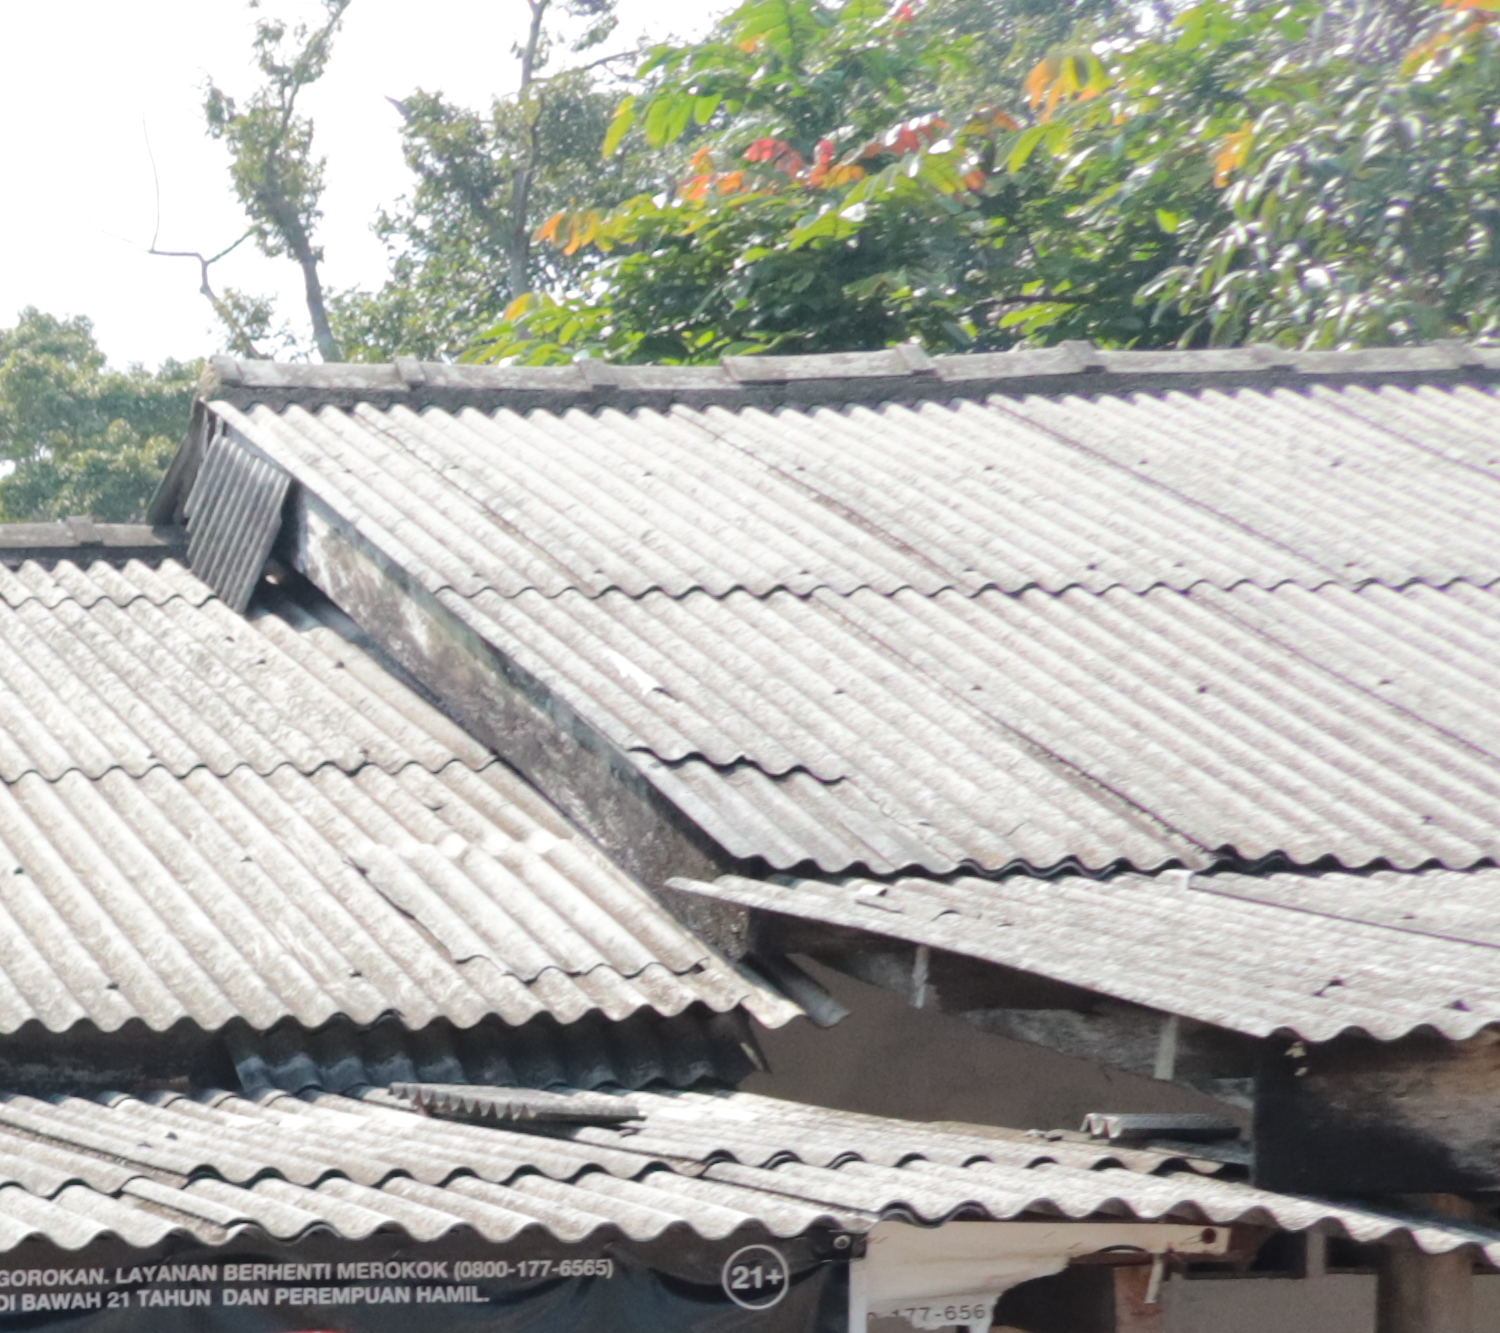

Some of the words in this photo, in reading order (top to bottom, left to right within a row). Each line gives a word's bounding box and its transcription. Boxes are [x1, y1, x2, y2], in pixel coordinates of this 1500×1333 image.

[115, 1264, 217, 1284] LAYANAN
[223, 1262, 331, 1282] BERHENTI
[337, 1260, 448, 1280] MEROKOK
[453, 1258, 614, 1281] (0800-177-6565)
[730, 1265, 783, 1290] 21+
[21, 1291, 101, 1311] BAWAH
[106, 1291, 129, 1308] 21
[136, 1288, 211, 1307] TAHUN
[222, 1287, 269, 1306] DAN
[274, 1286, 411, 1305] PEREMPUAN
[416, 1285, 490, 1304] HAMIL.
